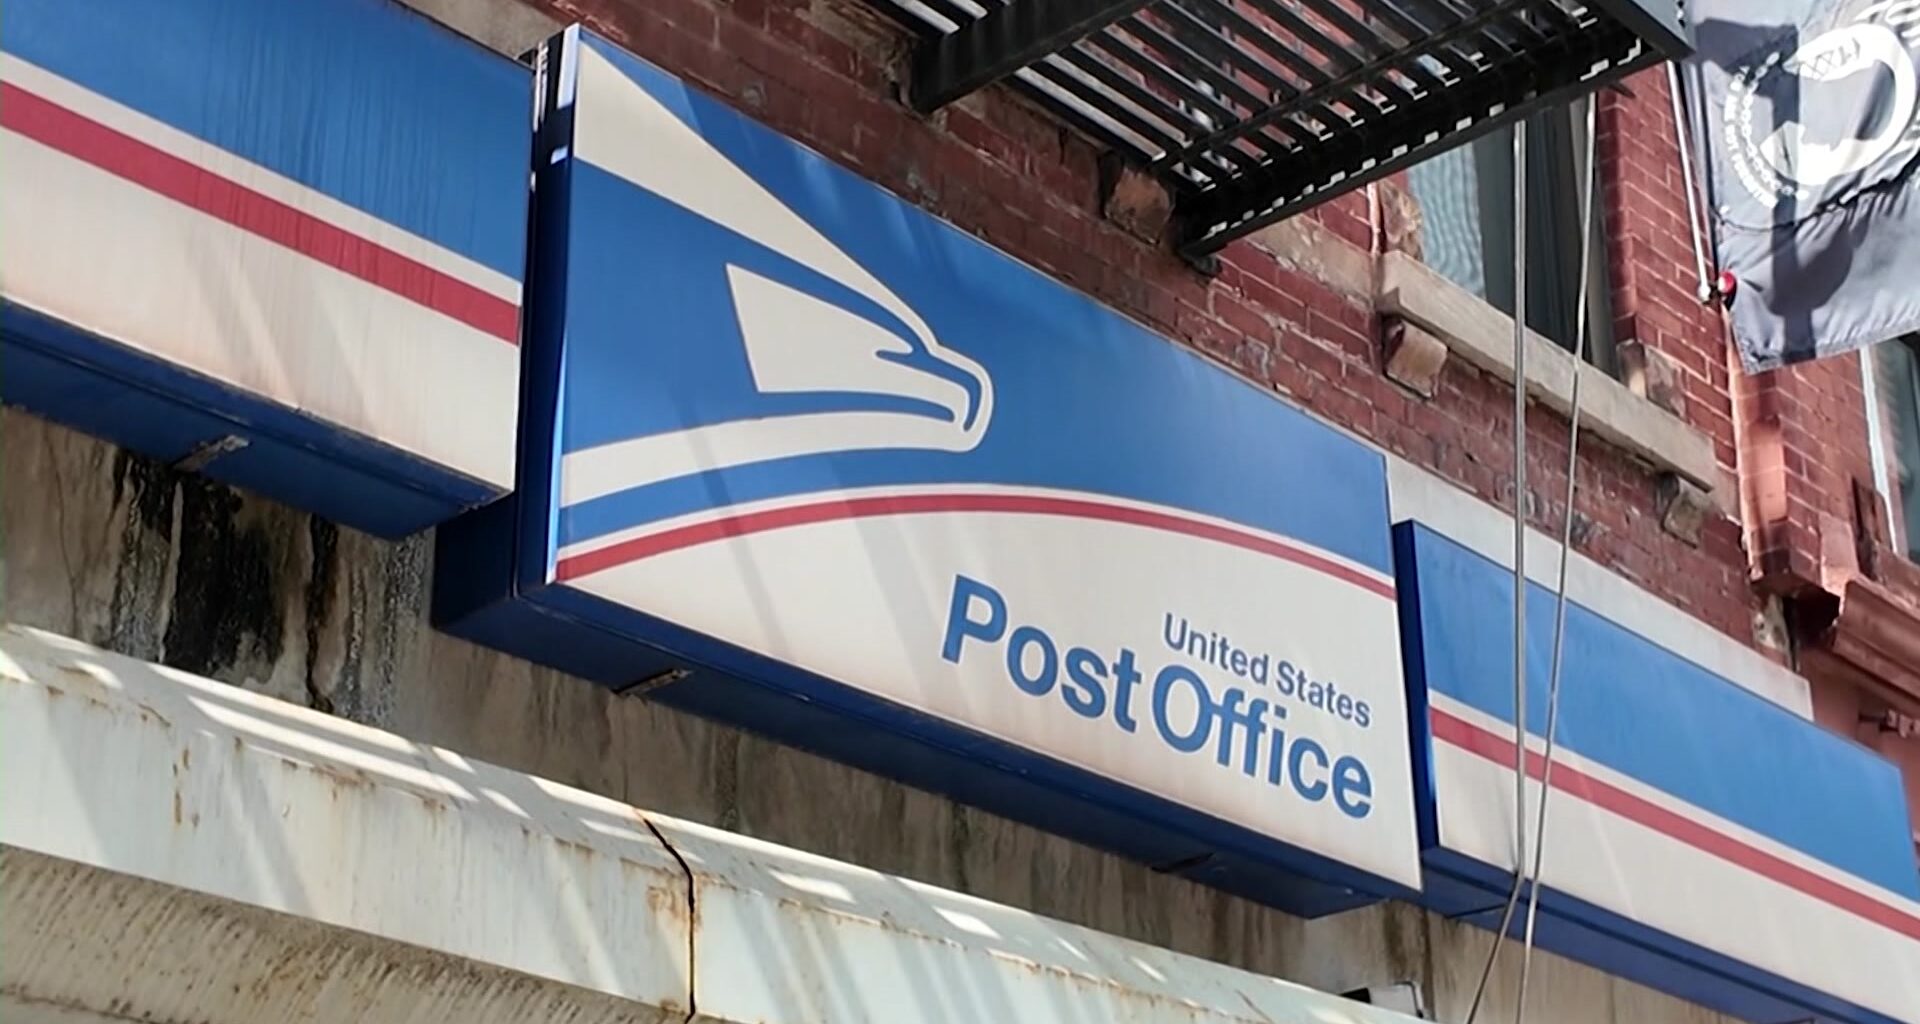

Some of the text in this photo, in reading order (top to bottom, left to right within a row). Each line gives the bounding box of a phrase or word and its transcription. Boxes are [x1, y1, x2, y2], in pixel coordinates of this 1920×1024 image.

[942, 574, 1373, 820] Post Office
[1164, 613, 1371, 727] United States
